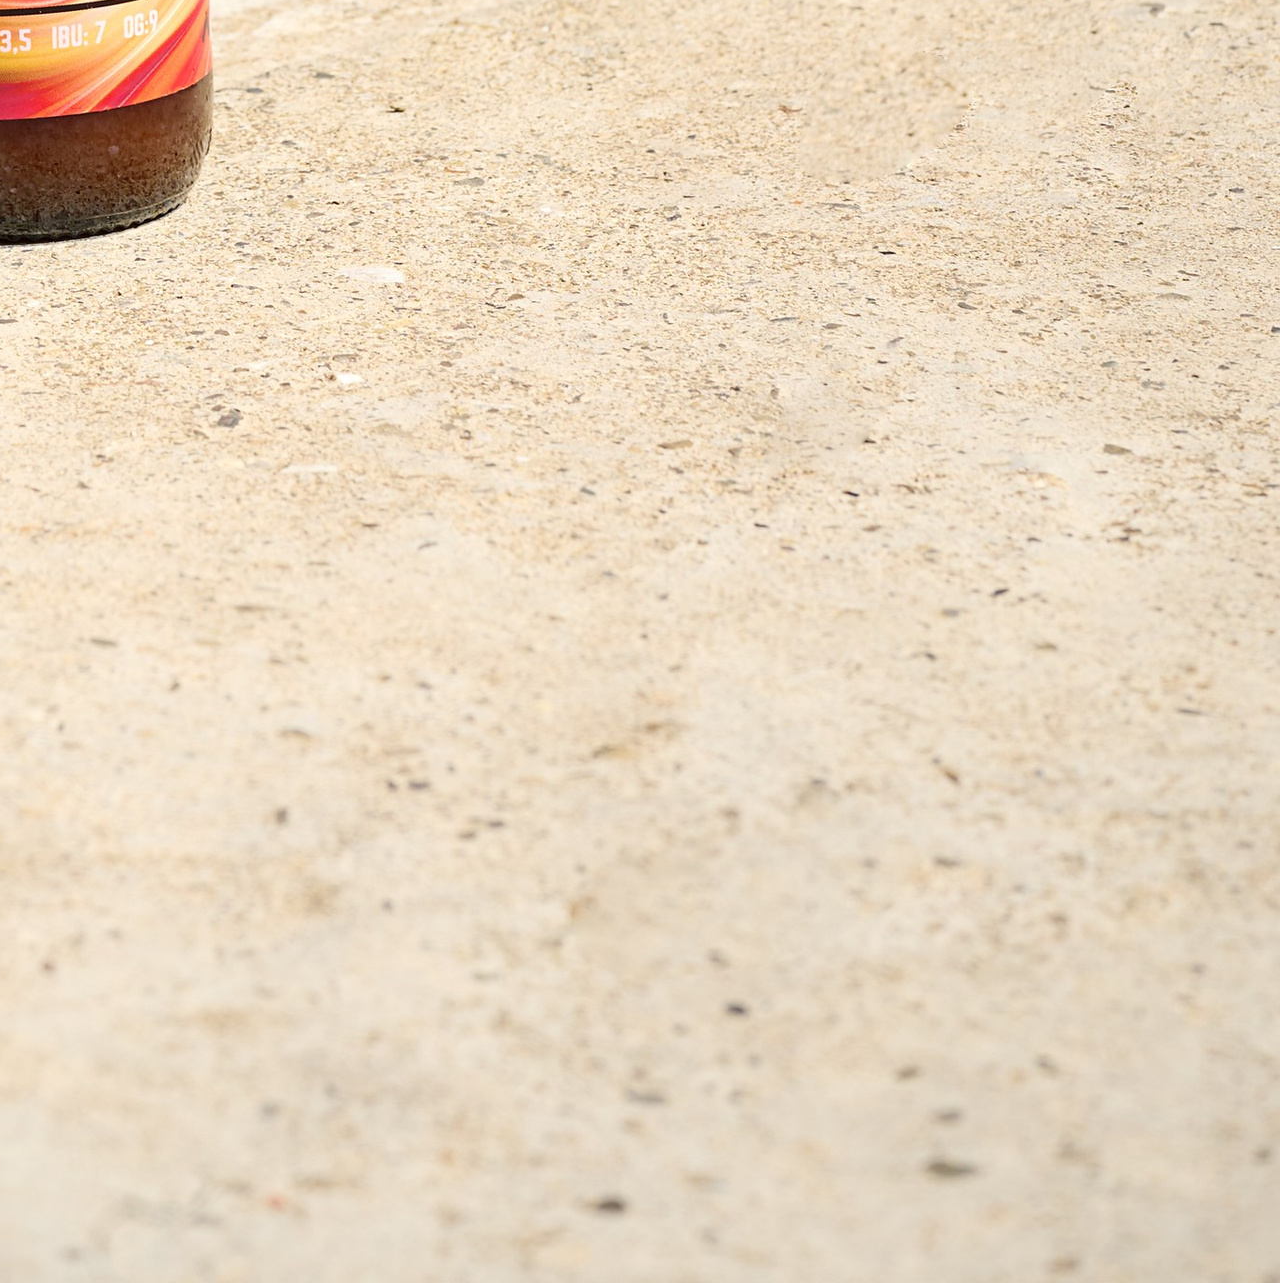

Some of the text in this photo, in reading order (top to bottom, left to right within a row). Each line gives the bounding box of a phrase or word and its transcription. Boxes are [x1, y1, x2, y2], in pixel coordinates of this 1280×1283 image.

[0, 29, 31, 55] 3,5
[51, 25, 88, 50] IBU:
[95, 21, 107, 44] 7
[123, 10, 158, 39] OG:9
